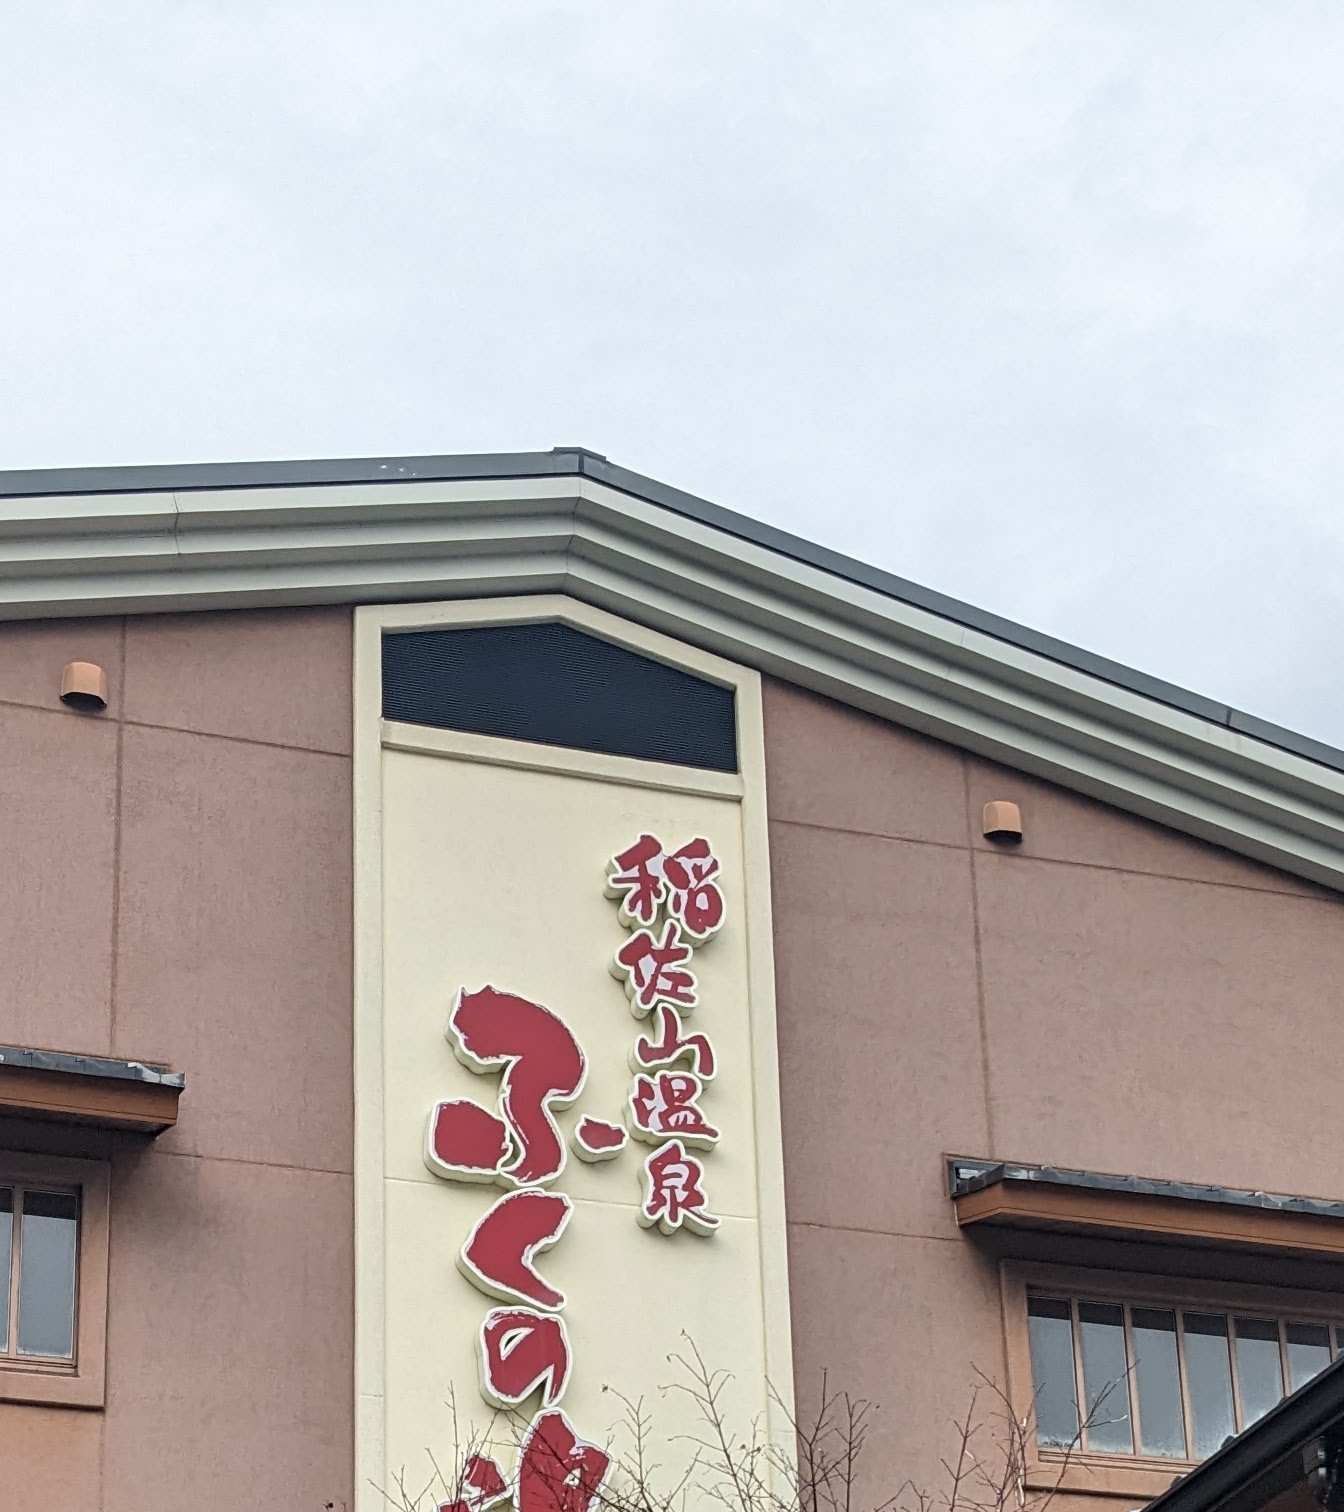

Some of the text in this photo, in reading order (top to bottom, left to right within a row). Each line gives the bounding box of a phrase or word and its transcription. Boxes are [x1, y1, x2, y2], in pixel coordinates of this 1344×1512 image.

[611, 834, 725, 1233] 稲佐山温泉
